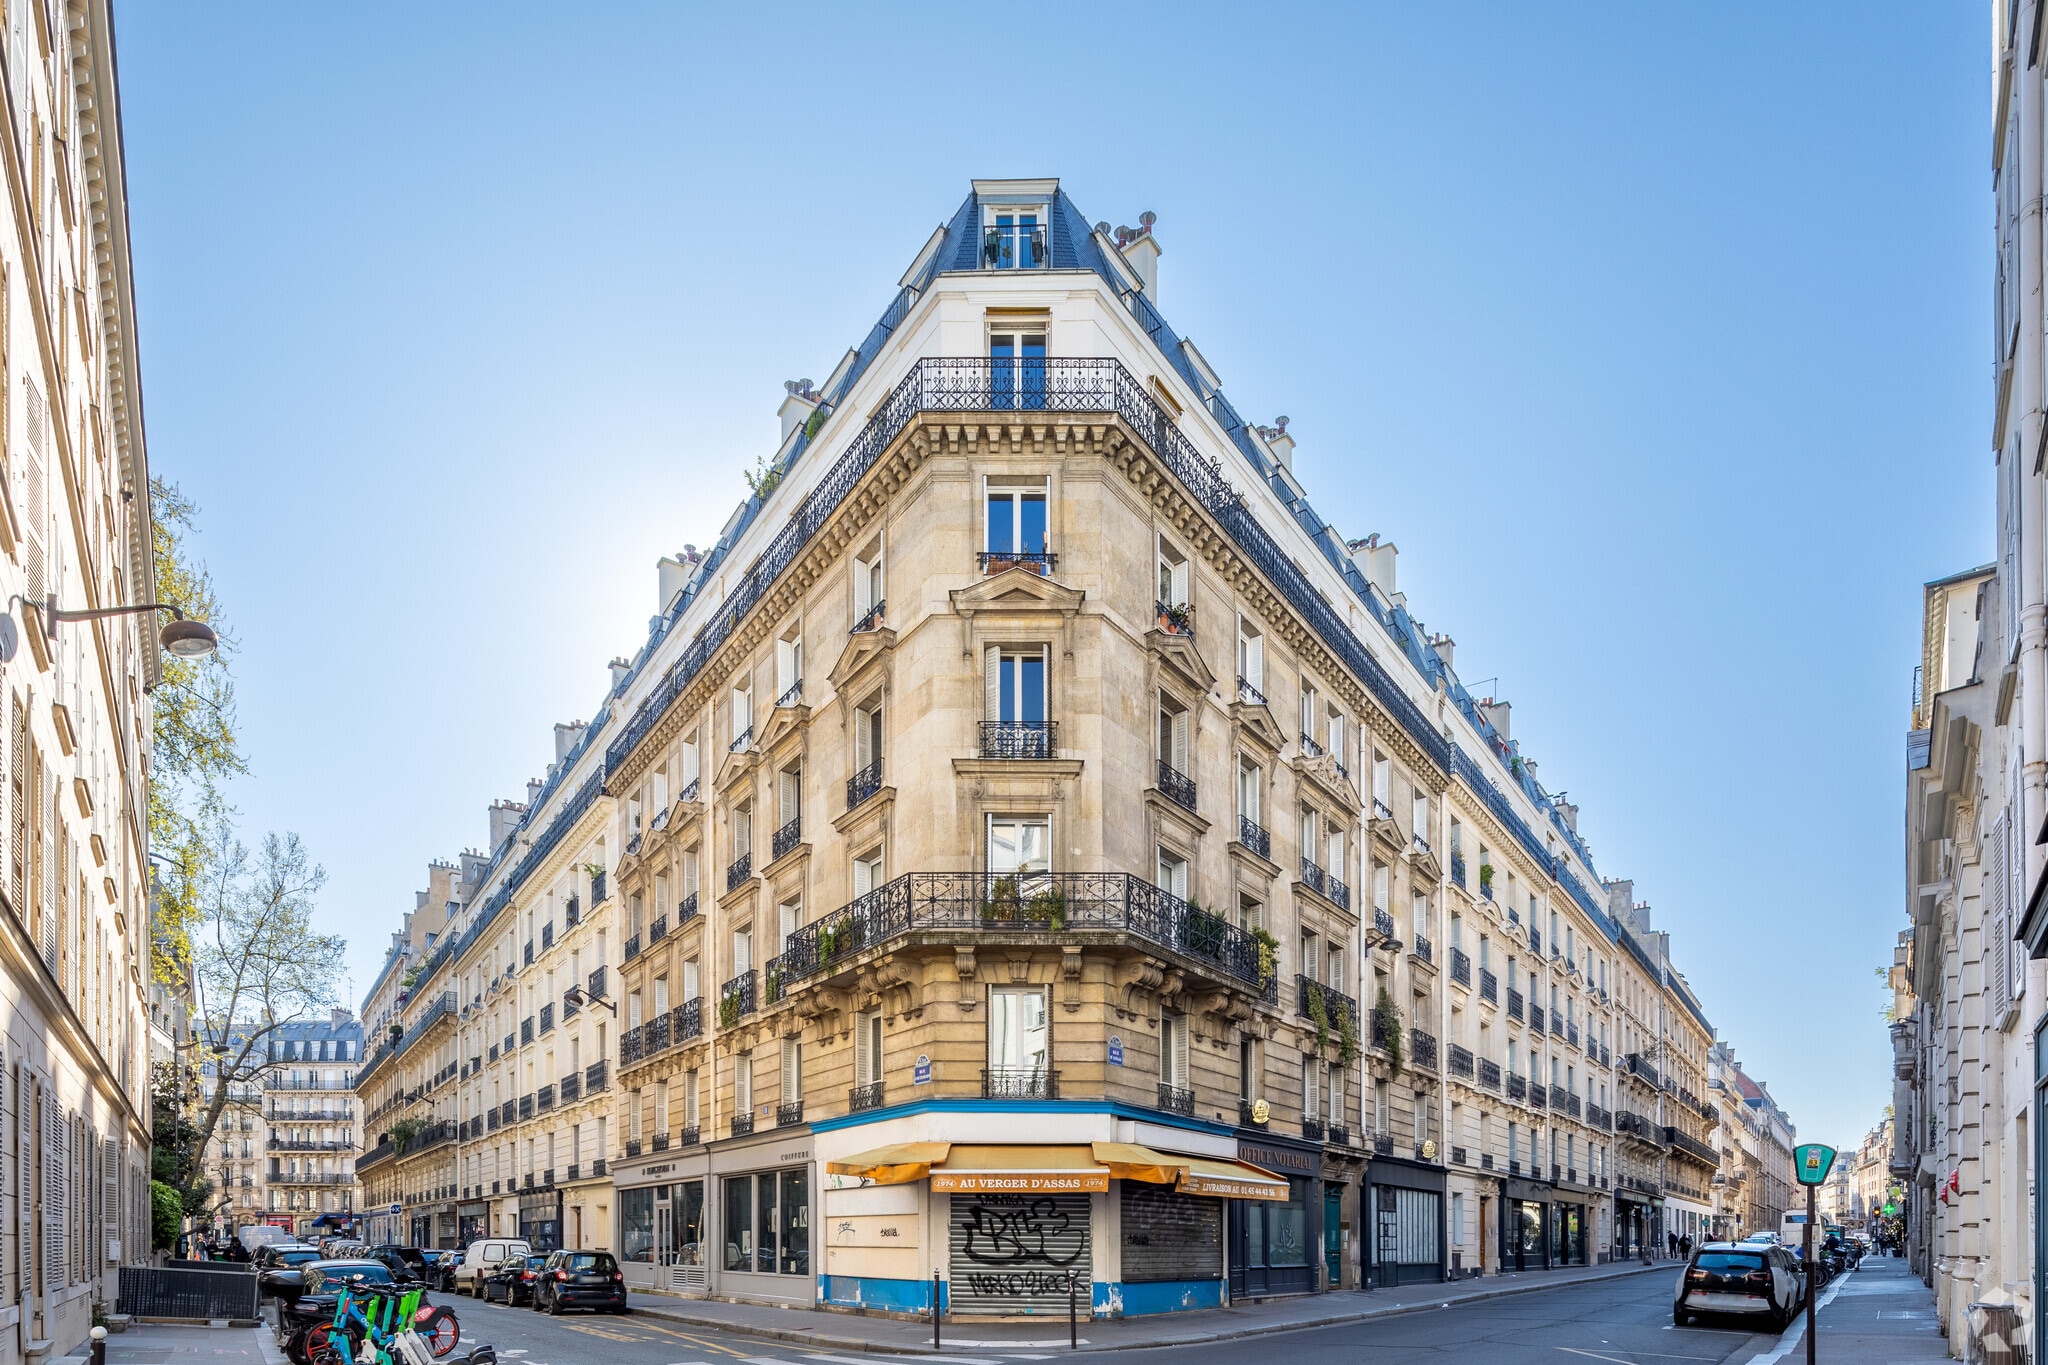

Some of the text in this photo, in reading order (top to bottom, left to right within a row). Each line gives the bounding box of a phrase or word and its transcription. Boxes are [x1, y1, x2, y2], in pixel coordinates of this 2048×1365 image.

[780, 1151, 808, 1160] COIFFURE
[1240, 1146, 1312, 1169] OFFICE NOTARIAL
[959, 1179, 1081, 1188] AU VERGER D'ASSAS
[1202, 1184, 1232, 1193] LIVRAISON
[1232, 1186, 1239, 1194] AU
[1241, 1186, 1247, 1194] 01
[1248, 1187, 1254, 1195] 45
